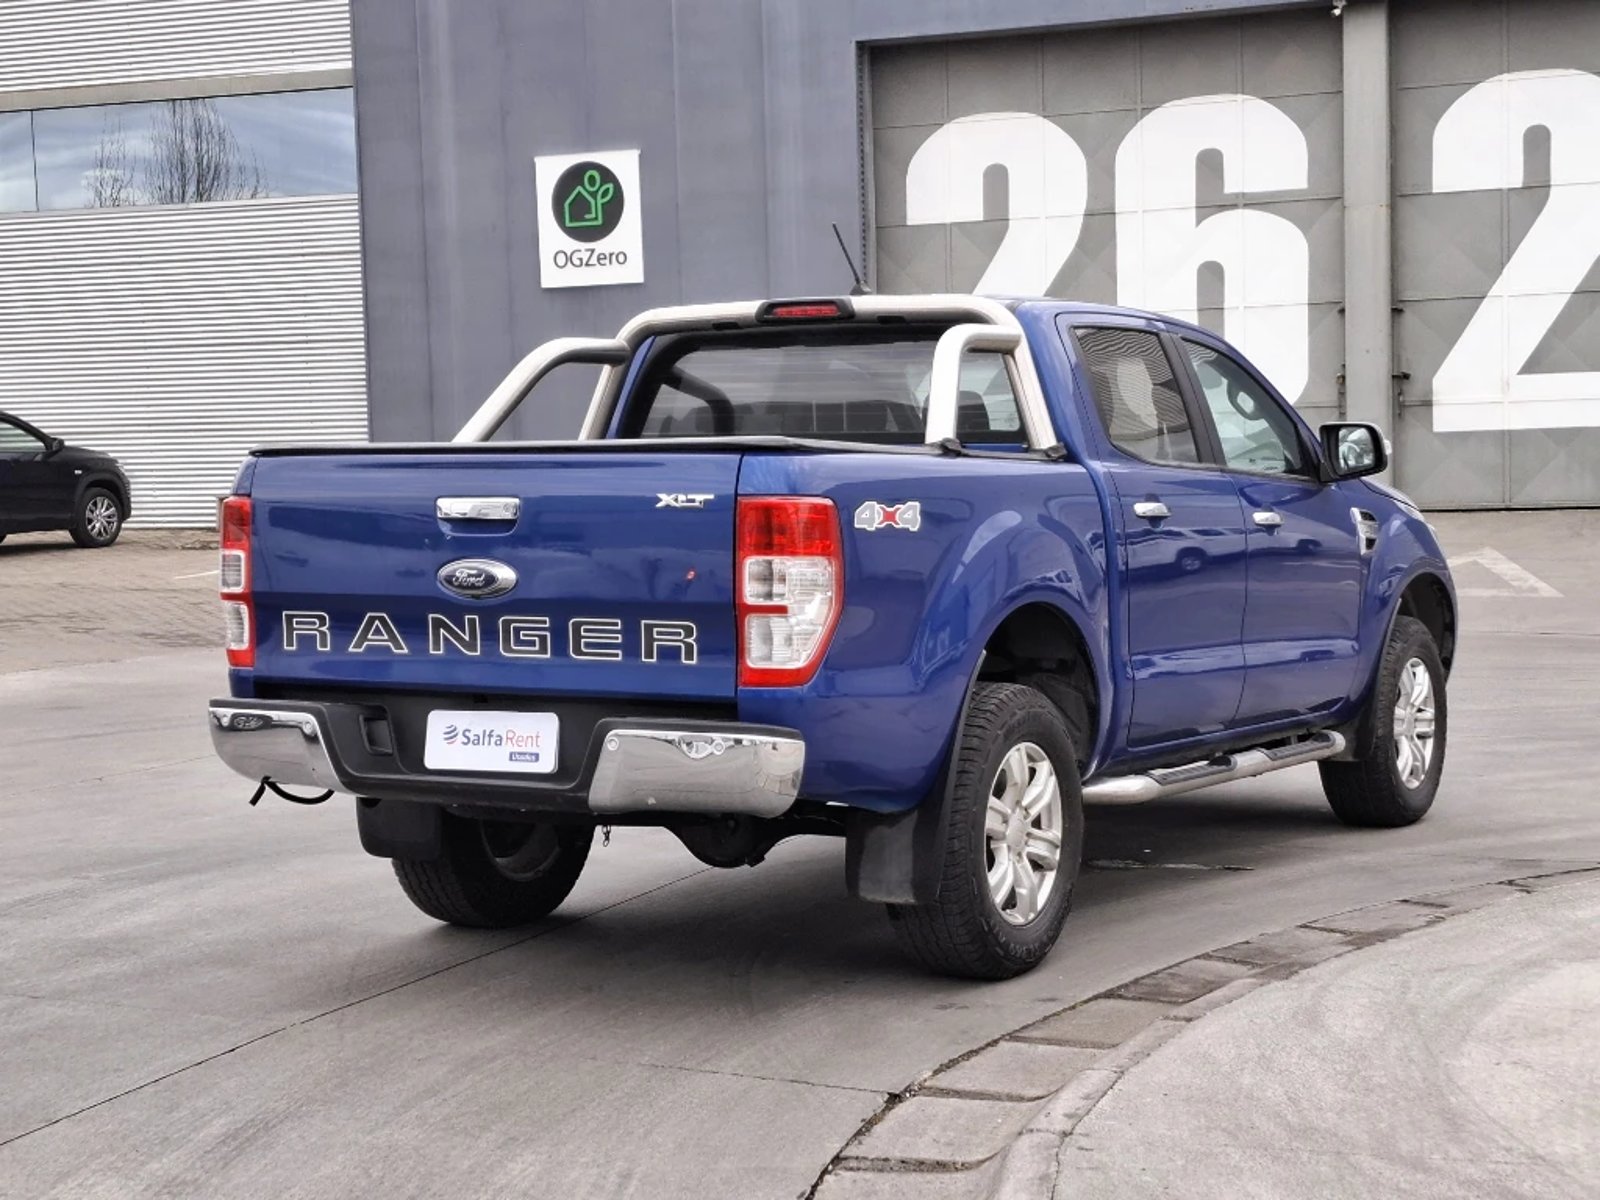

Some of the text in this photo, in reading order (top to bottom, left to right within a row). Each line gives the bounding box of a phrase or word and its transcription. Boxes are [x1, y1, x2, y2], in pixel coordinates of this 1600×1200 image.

[553, 247, 628, 270] OGZero
[905, 93, 1310, 408] 26
[1432, 68, 1600, 433] 2
[655, 493, 715, 508] XLT
[452, 568, 486, 587] Ford
[282, 610, 698, 664] RANGER
